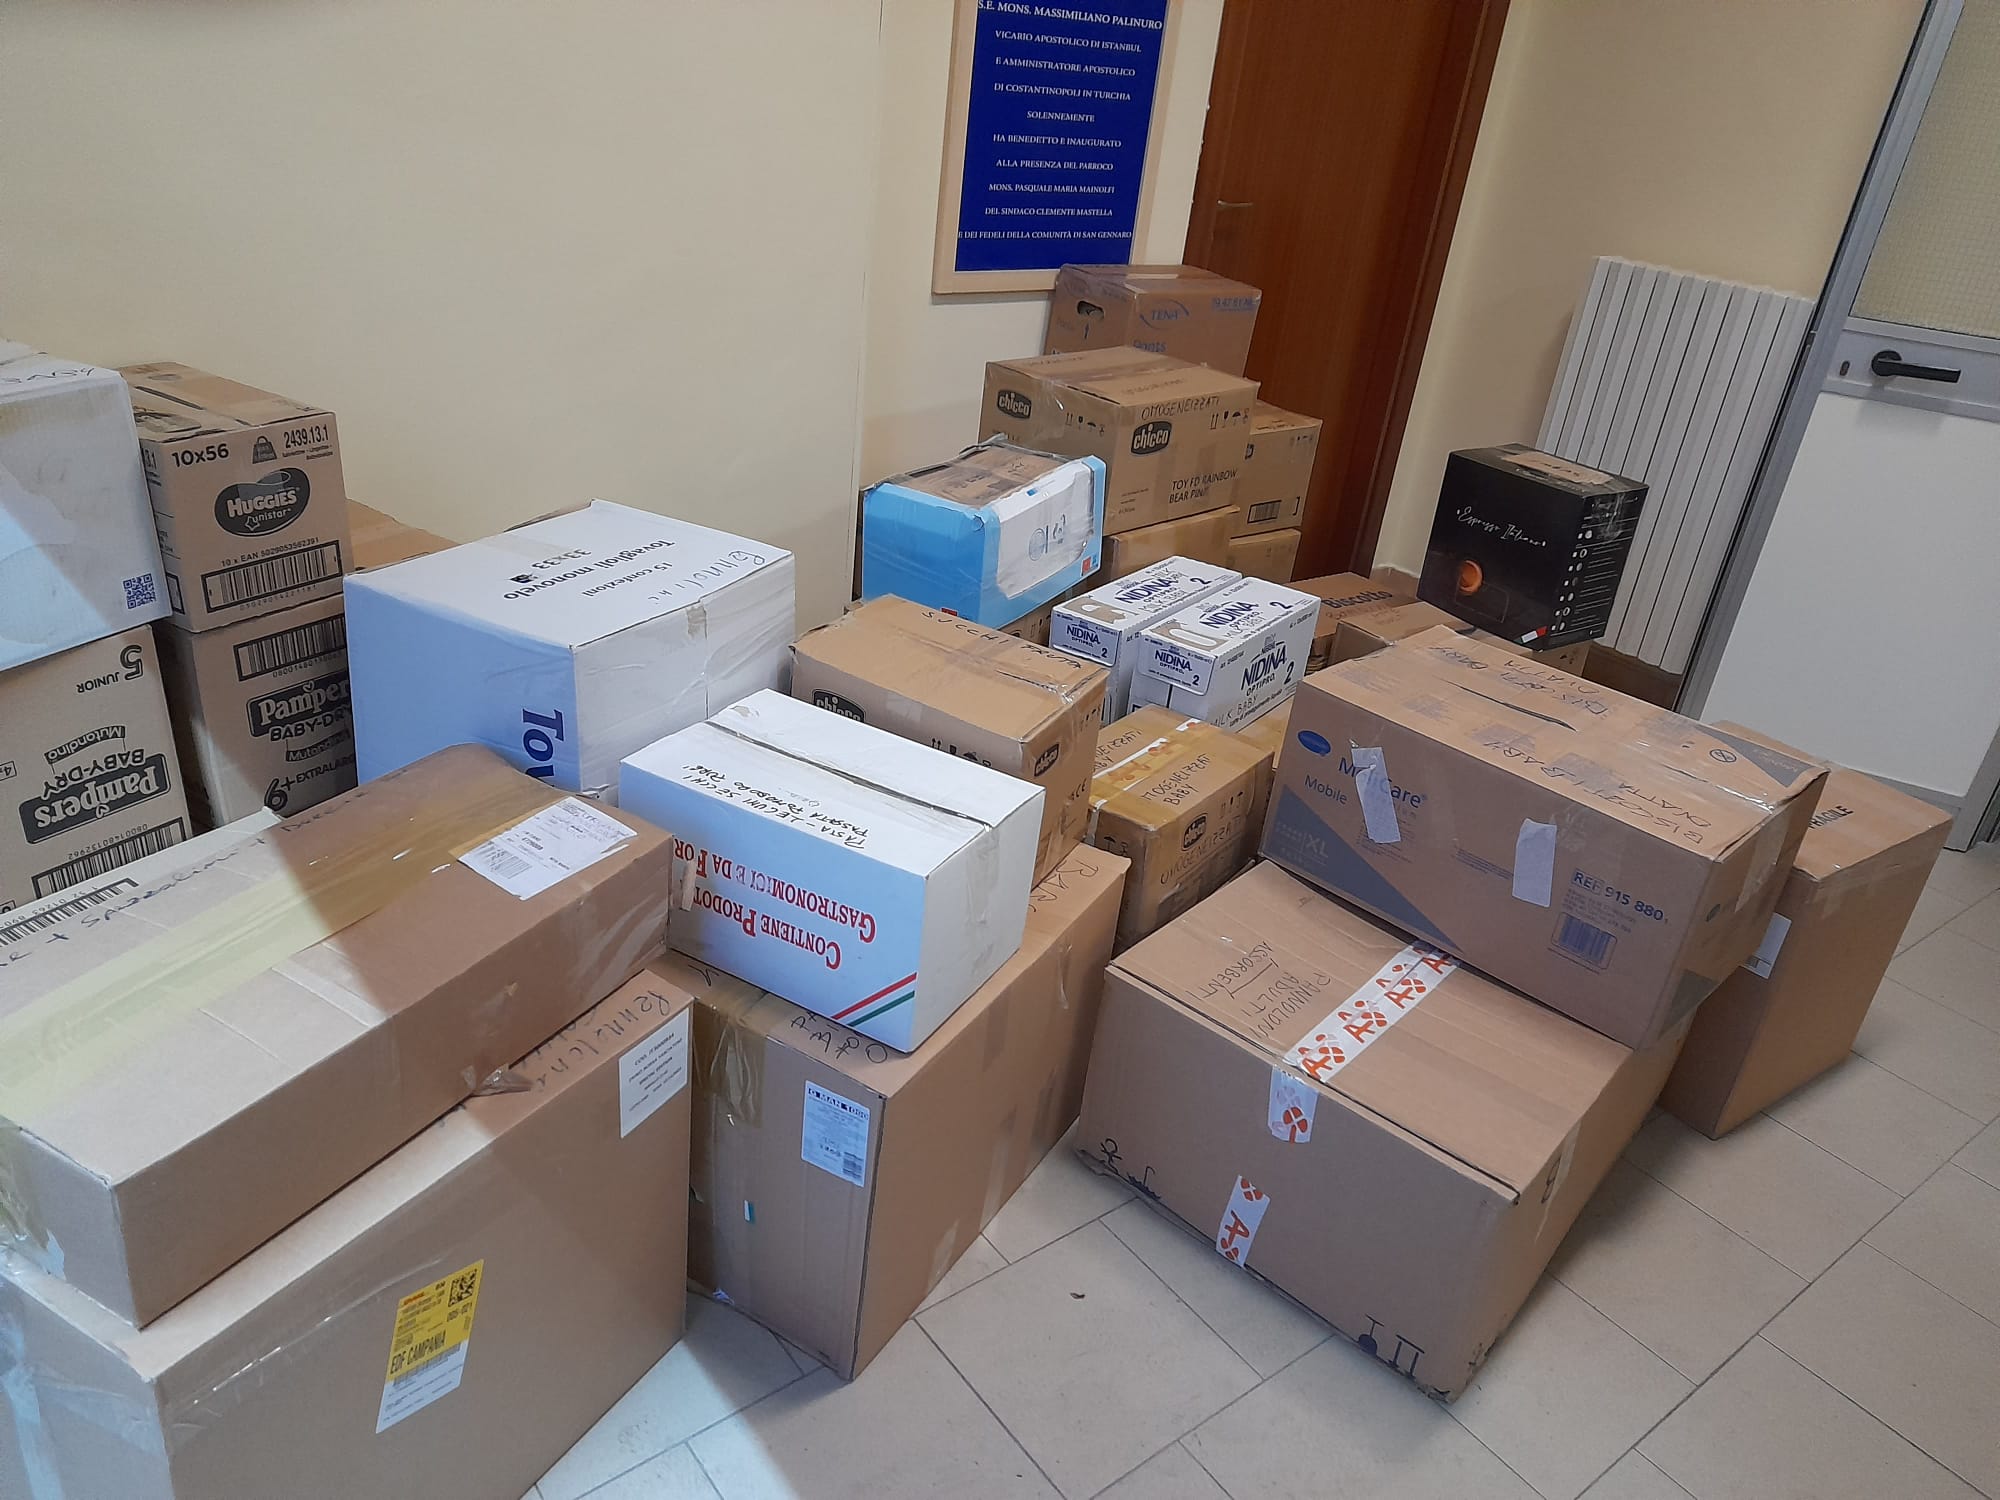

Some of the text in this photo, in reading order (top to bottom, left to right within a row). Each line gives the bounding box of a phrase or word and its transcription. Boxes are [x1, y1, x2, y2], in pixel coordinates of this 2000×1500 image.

[997, 2, 1032, 15] MONS.
[1034, 6, 1110, 24] MASSIMILIANO
[1112, 15, 1163, 30] PALINURO
[995, 30, 1142, 53] VICARIO APOSTOLICO DI ISTANBUL
[995, 57, 1136, 77] E AMMINISTRATORE APOSTOLICO
[994, 82, 1131, 101] DI COSTANTINOPOLI IN TURCHIA
[1027, 110, 1095, 123] SOLENNEMENTE
[993, 134, 1122, 148] HA BENEDETTO E INAUGURATO
[996, 159, 1018, 168] ALLA
[1020, 160, 1062, 169] PRESENZA
[1079, 162, 1114, 171] PARROCO
[989, 183, 1115, 194] MONS. PASQUALE MARIA MAINOLFI
[985, 207, 1113, 216] DEL SINDACO CLEMENTE MASTELLA
[964, 231, 978, 239] DEI
[979, 231, 1005, 239] FEDELI
[1006, 231, 1030, 239] DELLA
[1031, 230, 1072, 239] COMUNITÀ
[1073, 231, 1081, 239] DI
[1082, 231, 1097, 239] SAN
[1097, 231, 1132, 239] GENNARO
[998, 391, 1031, 416] chicco
[283, 425, 329, 449] 2439.13.1
[1133, 422, 1170, 451] chicco
[171, 443, 229, 468] 10x56
[1172, 478, 1189, 491] TOY
[227, 490, 297, 518] HUGGIES
[1169, 491, 1189, 504] BEAR
[252, 508, 291, 525] unistar
[221, 558, 231, 567] 10
[240, 552, 259, 562] EAN
[503, 540, 675, 601] Tovaglioli monovelo
[532, 547, 591, 570] 33x33
[581, 561, 674, 598] 15 confezioni
[1114, 578, 1173, 604] NIDINA
[1190, 576, 1211, 587] 2
[1200, 601, 1257, 629] NIDINA
[1269, 601, 1293, 610] 2
[1066, 625, 1101, 645] NIDINA
[1101, 647, 1108, 659] 2
[1155, 650, 1193, 671] NIDINA
[77, 644, 144, 693] JUNIOR 5
[1192, 674, 1200, 686] 2
[1240, 645, 1287, 690] NIDINA
[1283, 661, 1295, 686] 2
[47, 726, 122, 762] Mutandino
[42, 748, 145, 800] BABY-DRY
[34, 766, 160, 828] Pampers
[1163, 783, 1199, 806] BABY
[1305, 775, 1348, 805] Mobile
[712, 853, 732, 880] DA
[750, 869, 876, 944] GASTRONOMICI
[1573, 871, 1604, 892] REF
[1605, 886, 1631, 906] 915
[1633, 900, 1664, 921] 880
[761, 914, 842, 970] CONTIENE
[1186, 939, 1275, 1003] ASSORBENTI
[1243, 971, 1301, 1018] ADULTI
[1250, 971, 1333, 1040] PANNOLONI
